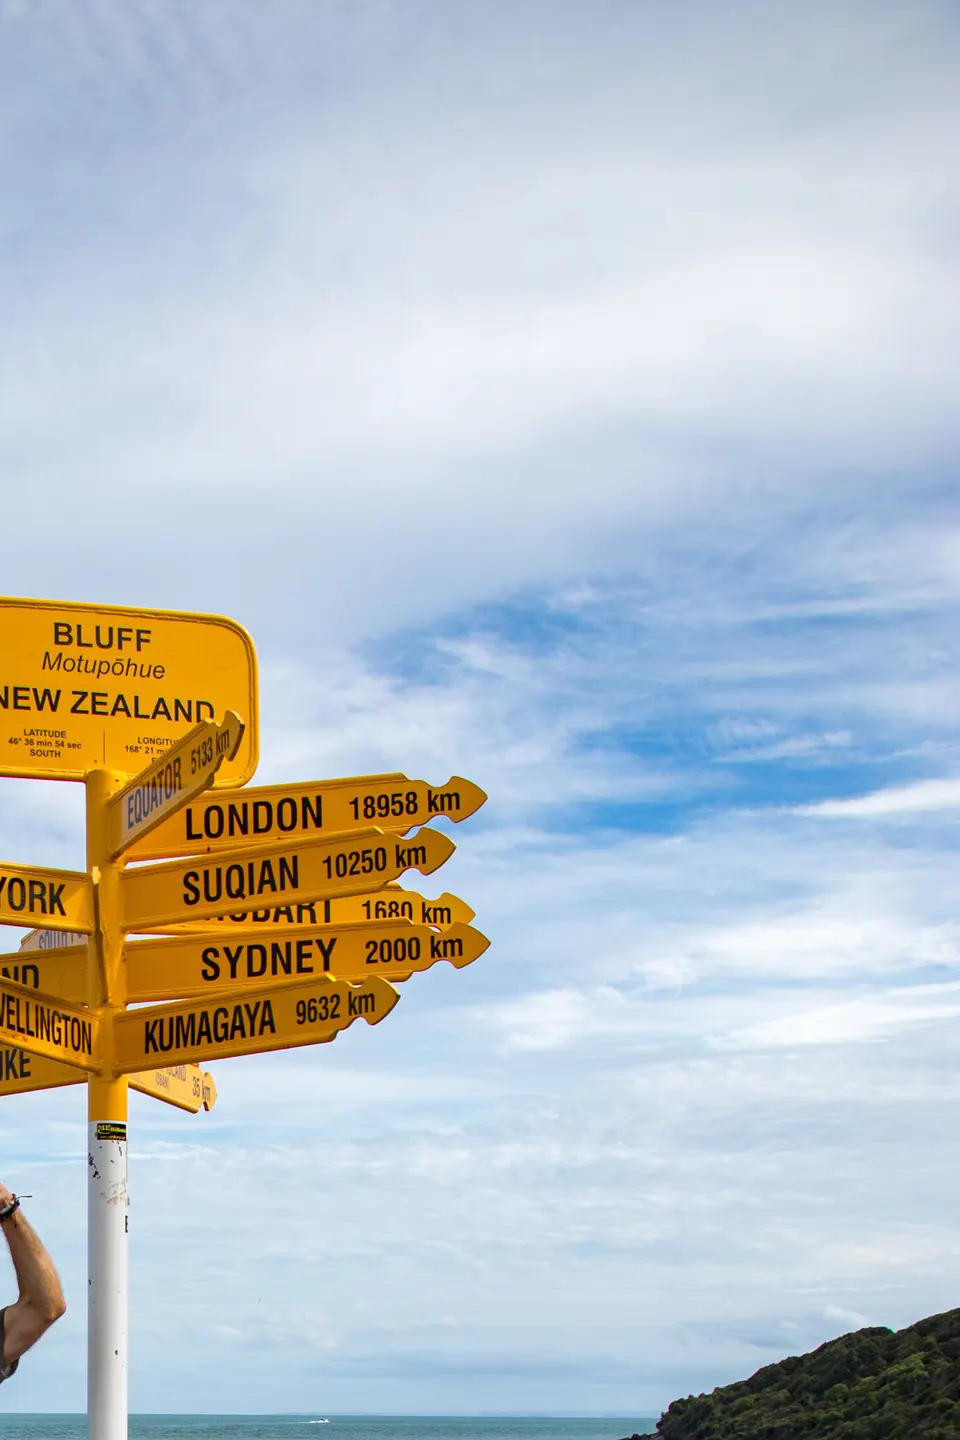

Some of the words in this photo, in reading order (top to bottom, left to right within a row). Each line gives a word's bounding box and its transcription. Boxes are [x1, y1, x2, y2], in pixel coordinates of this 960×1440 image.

[53, 621, 152, 652] BLUFF
[41, 651, 166, 680] Motupōhue
[69, 689, 215, 724] ZEALAND
[8, 737, 22, 746] 46°
[24, 738, 35, 747] 36
[36, 739, 53, 748] min
[54, 740, 65, 749] 54
[66, 742, 83, 750] sec
[23, 728, 67, 739] LATITUDE
[137, 736, 179, 747] LONGITU
[29, 748, 62, 759] SOUTH
[144, 746, 154, 754] 21
[127, 756, 183, 830] EQUATOR
[190, 736, 214, 775] 5133
[215, 728, 231, 757] km
[185, 794, 324, 841] LONDON
[348, 790, 419, 822] 18958
[426, 788, 461, 815] km
[182, 854, 300, 906] SUQIAN
[321, 845, 388, 880] 10250
[394, 844, 427, 869] km
[361, 899, 414, 921] 1680
[421, 901, 452, 924] km
[200, 936, 338, 982] SYDNEY
[364, 936, 421, 965] 2000
[429, 933, 464, 959] km
[143, 999, 277, 1055] KUMAGAYA
[295, 993, 341, 1025] 9632
[347, 991, 376, 1016] km
